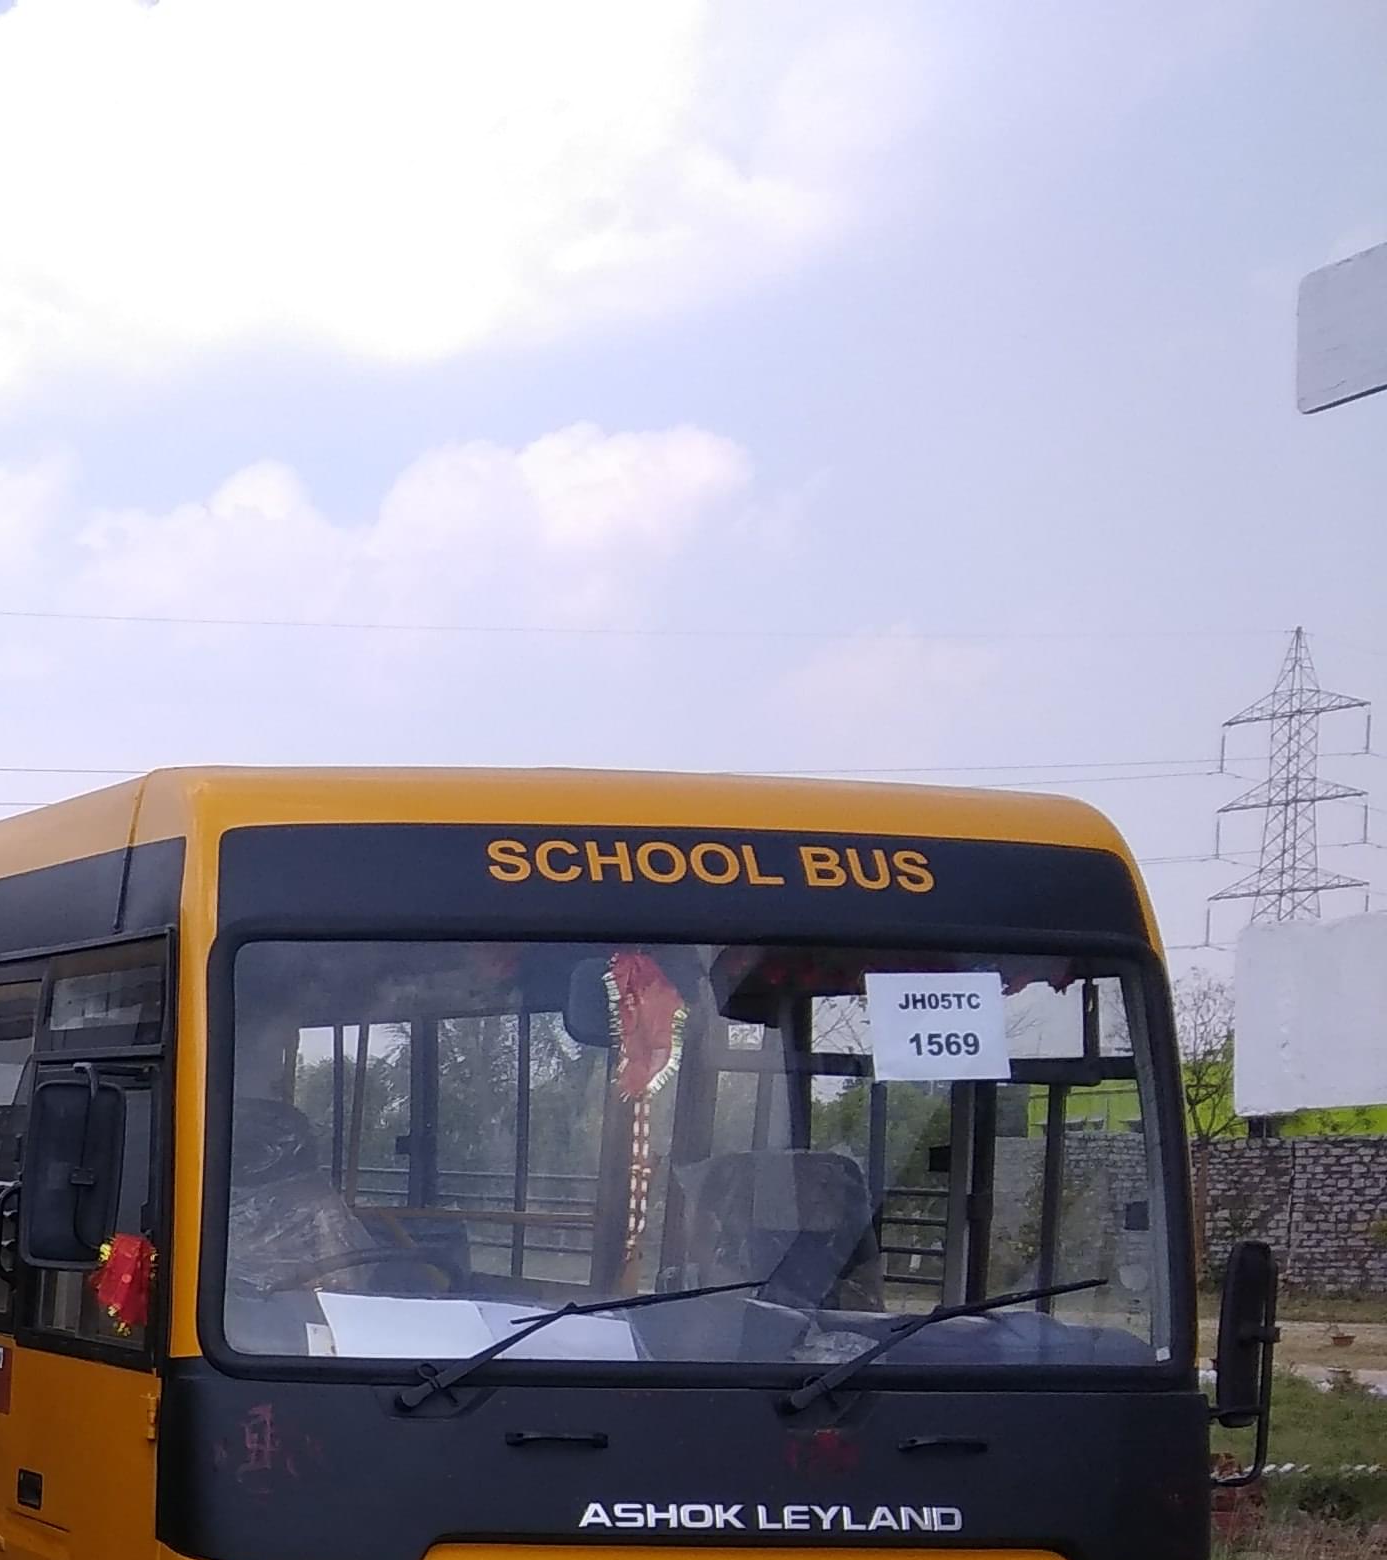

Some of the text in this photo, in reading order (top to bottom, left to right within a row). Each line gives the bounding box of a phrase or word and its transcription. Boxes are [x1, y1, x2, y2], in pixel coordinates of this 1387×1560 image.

[486, 840, 935, 893] SCHOOL BUS
[898, 993, 981, 1010] JH05TC
[909, 1032, 980, 1056] 1569
[578, 1502, 962, 1532] ASHOK LEYLAND
